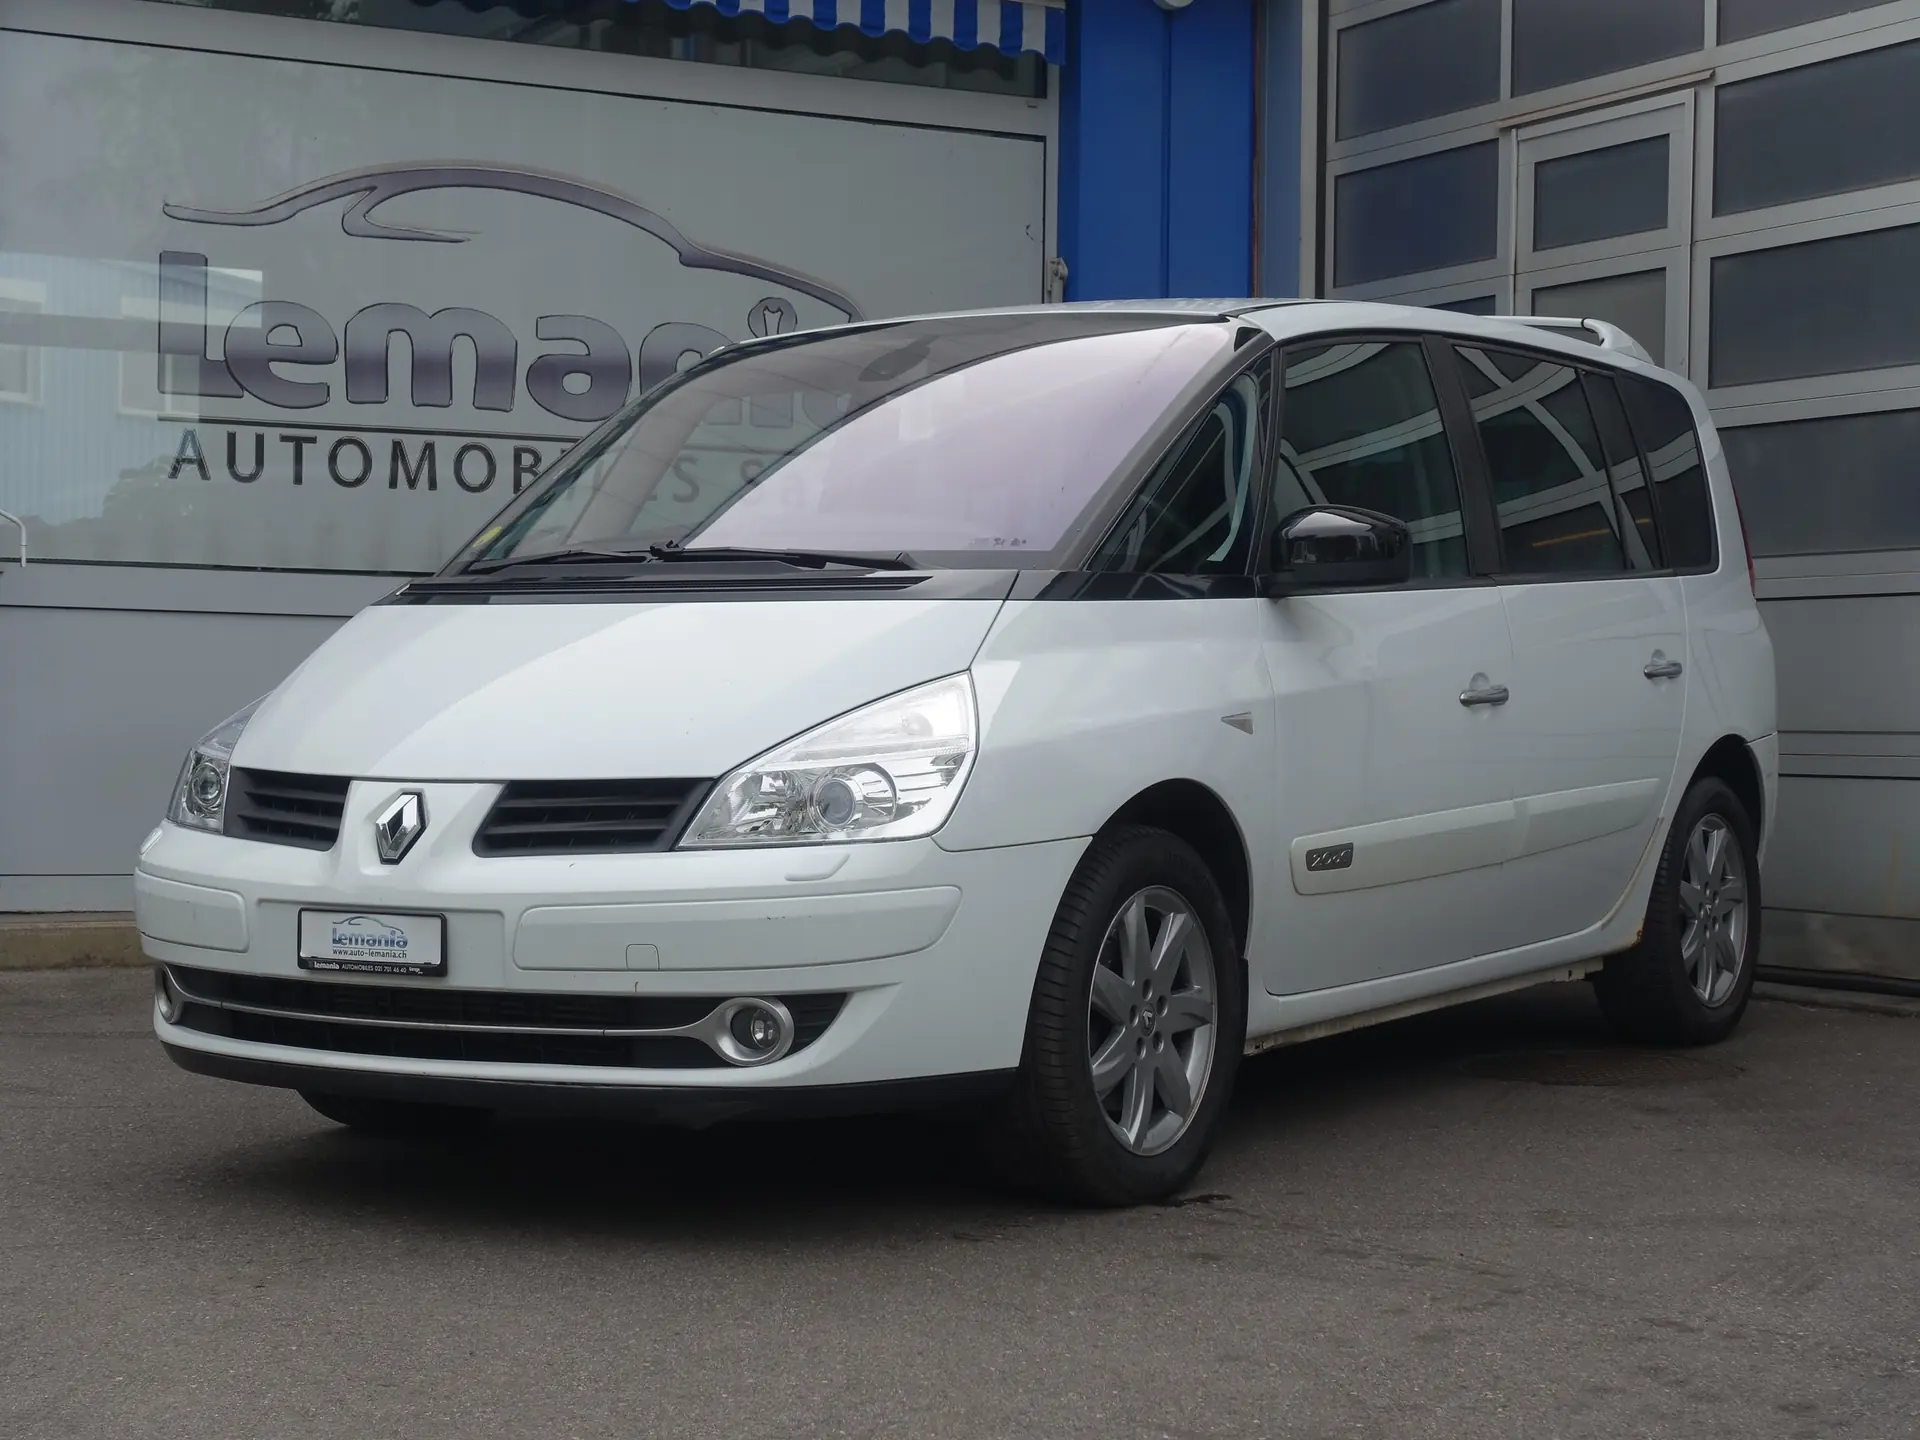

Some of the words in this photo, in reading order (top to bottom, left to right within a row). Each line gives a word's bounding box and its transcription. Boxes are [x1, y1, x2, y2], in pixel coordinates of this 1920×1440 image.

[332, 927, 408, 949] Lemania
[332, 948, 408, 959] www.auto-lemania.ch
[341, 964, 374, 972] AUTOMOBILES
